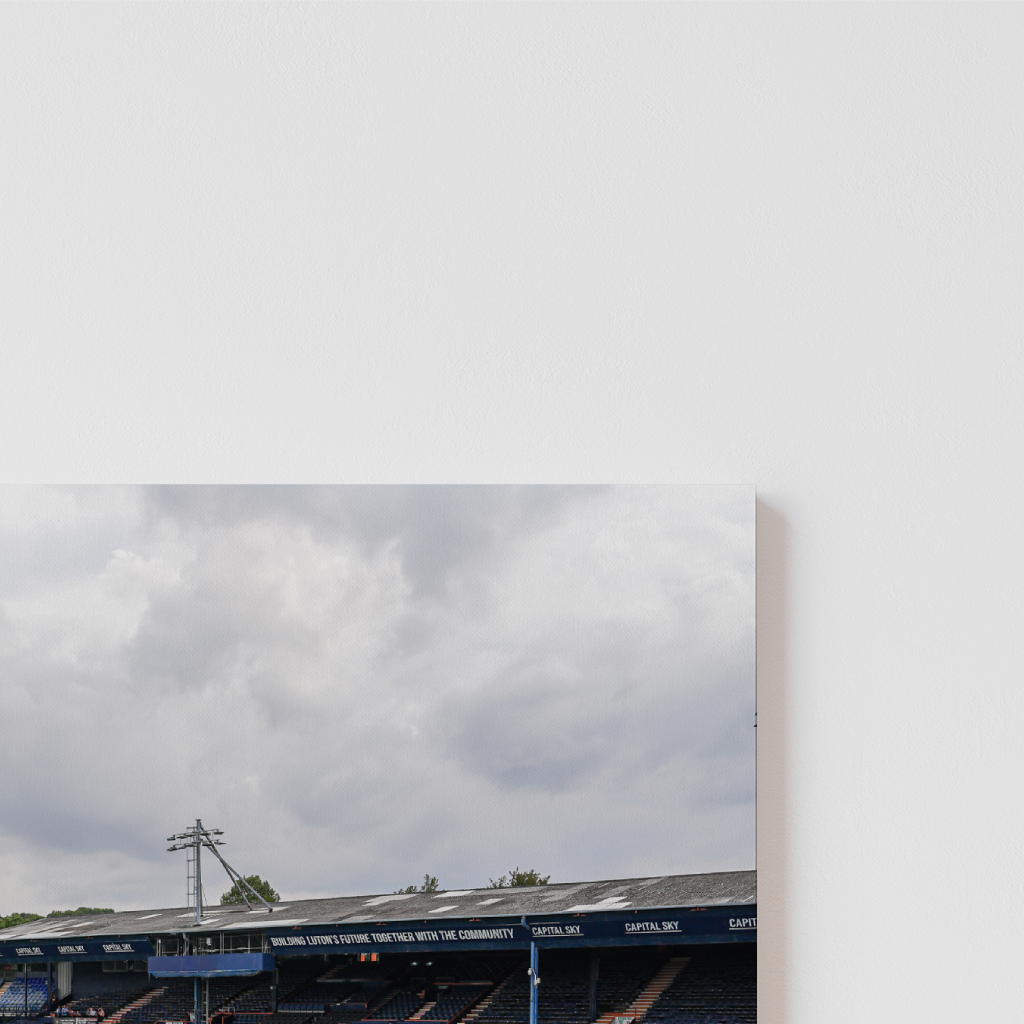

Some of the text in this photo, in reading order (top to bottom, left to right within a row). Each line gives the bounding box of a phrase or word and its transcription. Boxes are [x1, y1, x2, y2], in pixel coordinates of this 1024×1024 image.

[532, 925, 580, 935] CAPITAL SKY
[625, 921, 679, 932] CAPITAL SKY
[271, 928, 514, 946] BUILDING LUTON'S FUTURE TOGETHER WITH THE COMMUNITY
